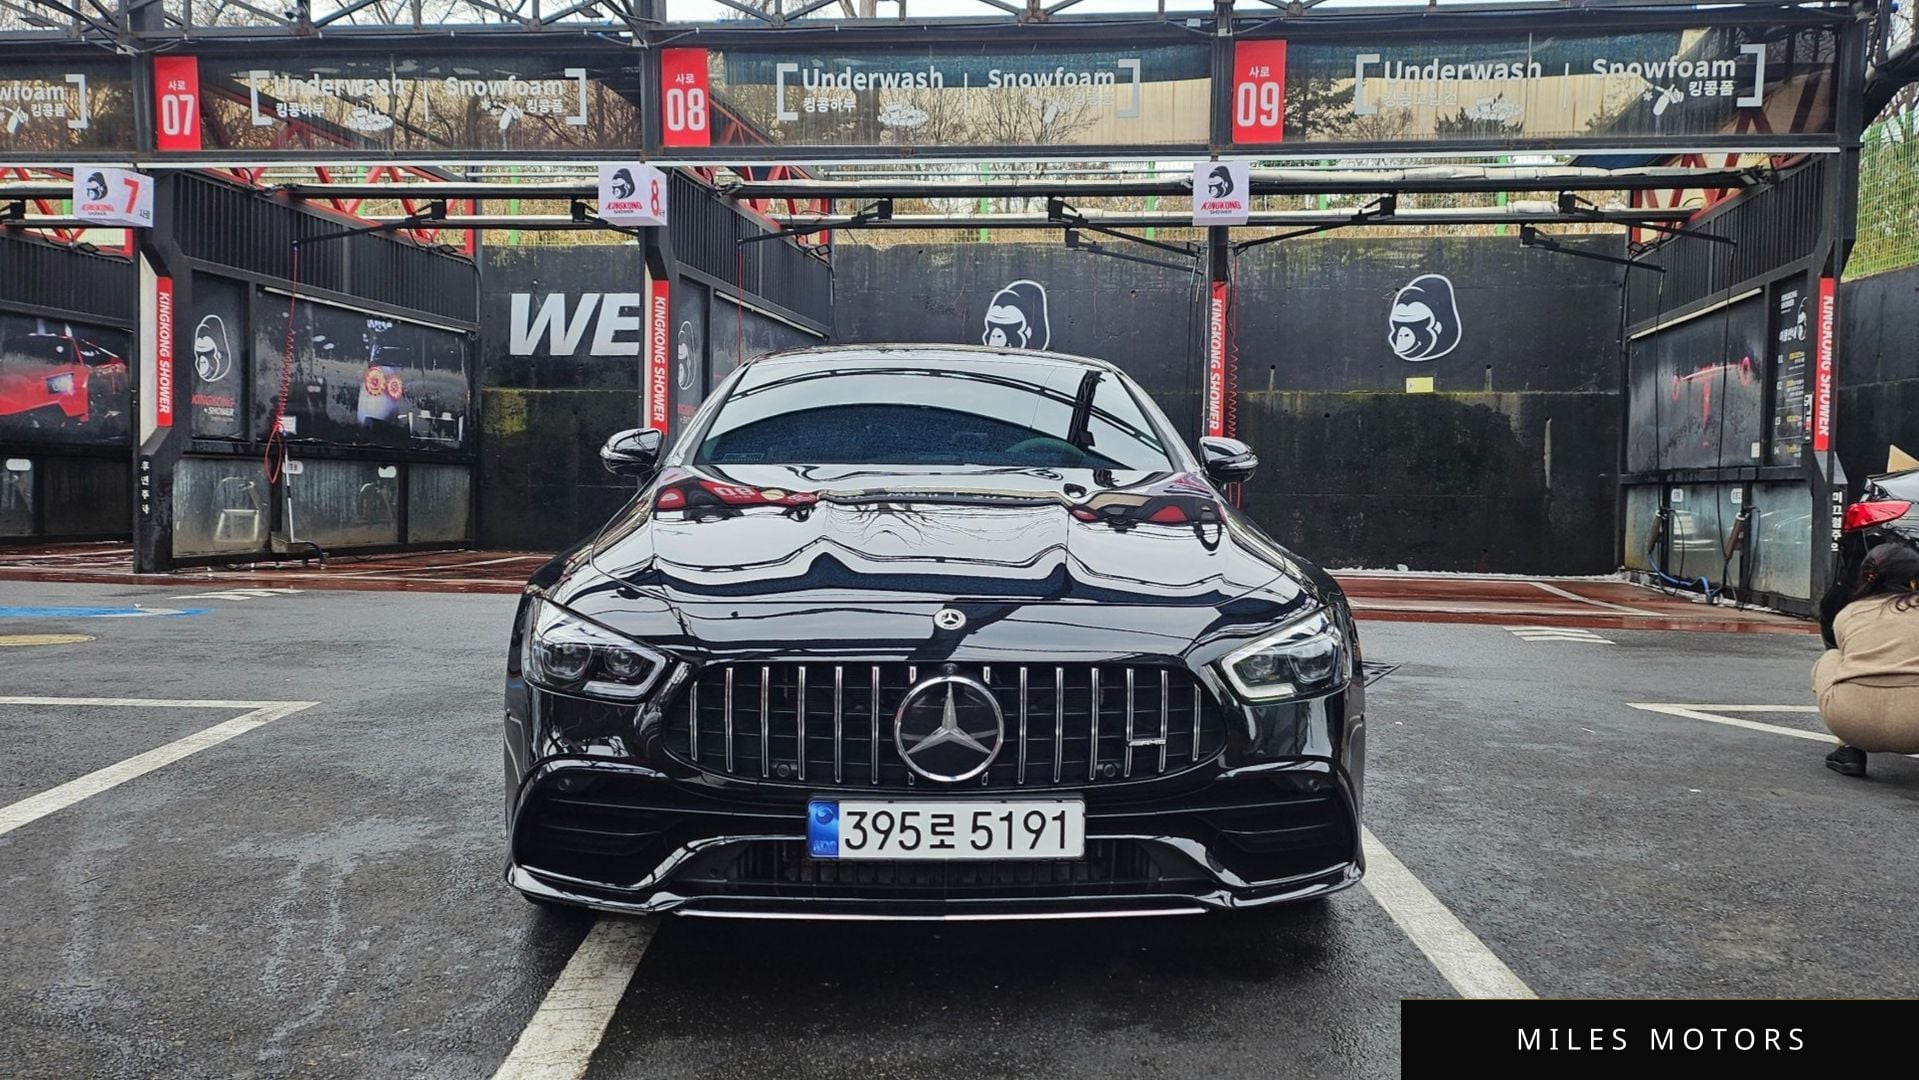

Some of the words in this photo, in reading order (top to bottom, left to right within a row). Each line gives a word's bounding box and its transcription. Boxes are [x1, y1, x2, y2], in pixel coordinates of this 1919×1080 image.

[168, 80, 186, 90] 사로
[274, 73, 404, 96] Underwash
[446, 75, 563, 96] Snowfoam
[675, 73, 695, 84] 사로
[803, 65, 943, 90] Underwash
[988, 67, 1115, 88] Snowfoam
[1249, 66, 1270, 78] 사로
[1385, 56, 1541, 82] Underwash
[1592, 55, 1736, 79] Snowfoam
[803, 96, 857, 112] 킹콩하부
[1237, 82, 1279, 127] 09
[1688, 80, 1735, 97] 킹콩폼
[162, 94, 195, 136] 07
[276, 102, 325, 118] 킹콩하부
[666, 88, 706, 131] 08
[123, 177, 140, 214] 7
[650, 179, 660, 216] 8
[1201, 201, 1242, 210] KINGKONG
[159, 291, 171, 358] KINGKONG
[509, 293, 640, 355] WE
[653, 296, 666, 364] KINGKONG
[1210, 298, 1222, 369] KINGKONG
[1820, 295, 1834, 371] KINGKONG
[159, 359, 171, 414] SHOWER
[653, 366, 666, 422] SHOWER
[1208, 371, 1221, 430] SHOWER
[845, 810, 955, 850] 395로
[970, 810, 1066, 850] 5191
